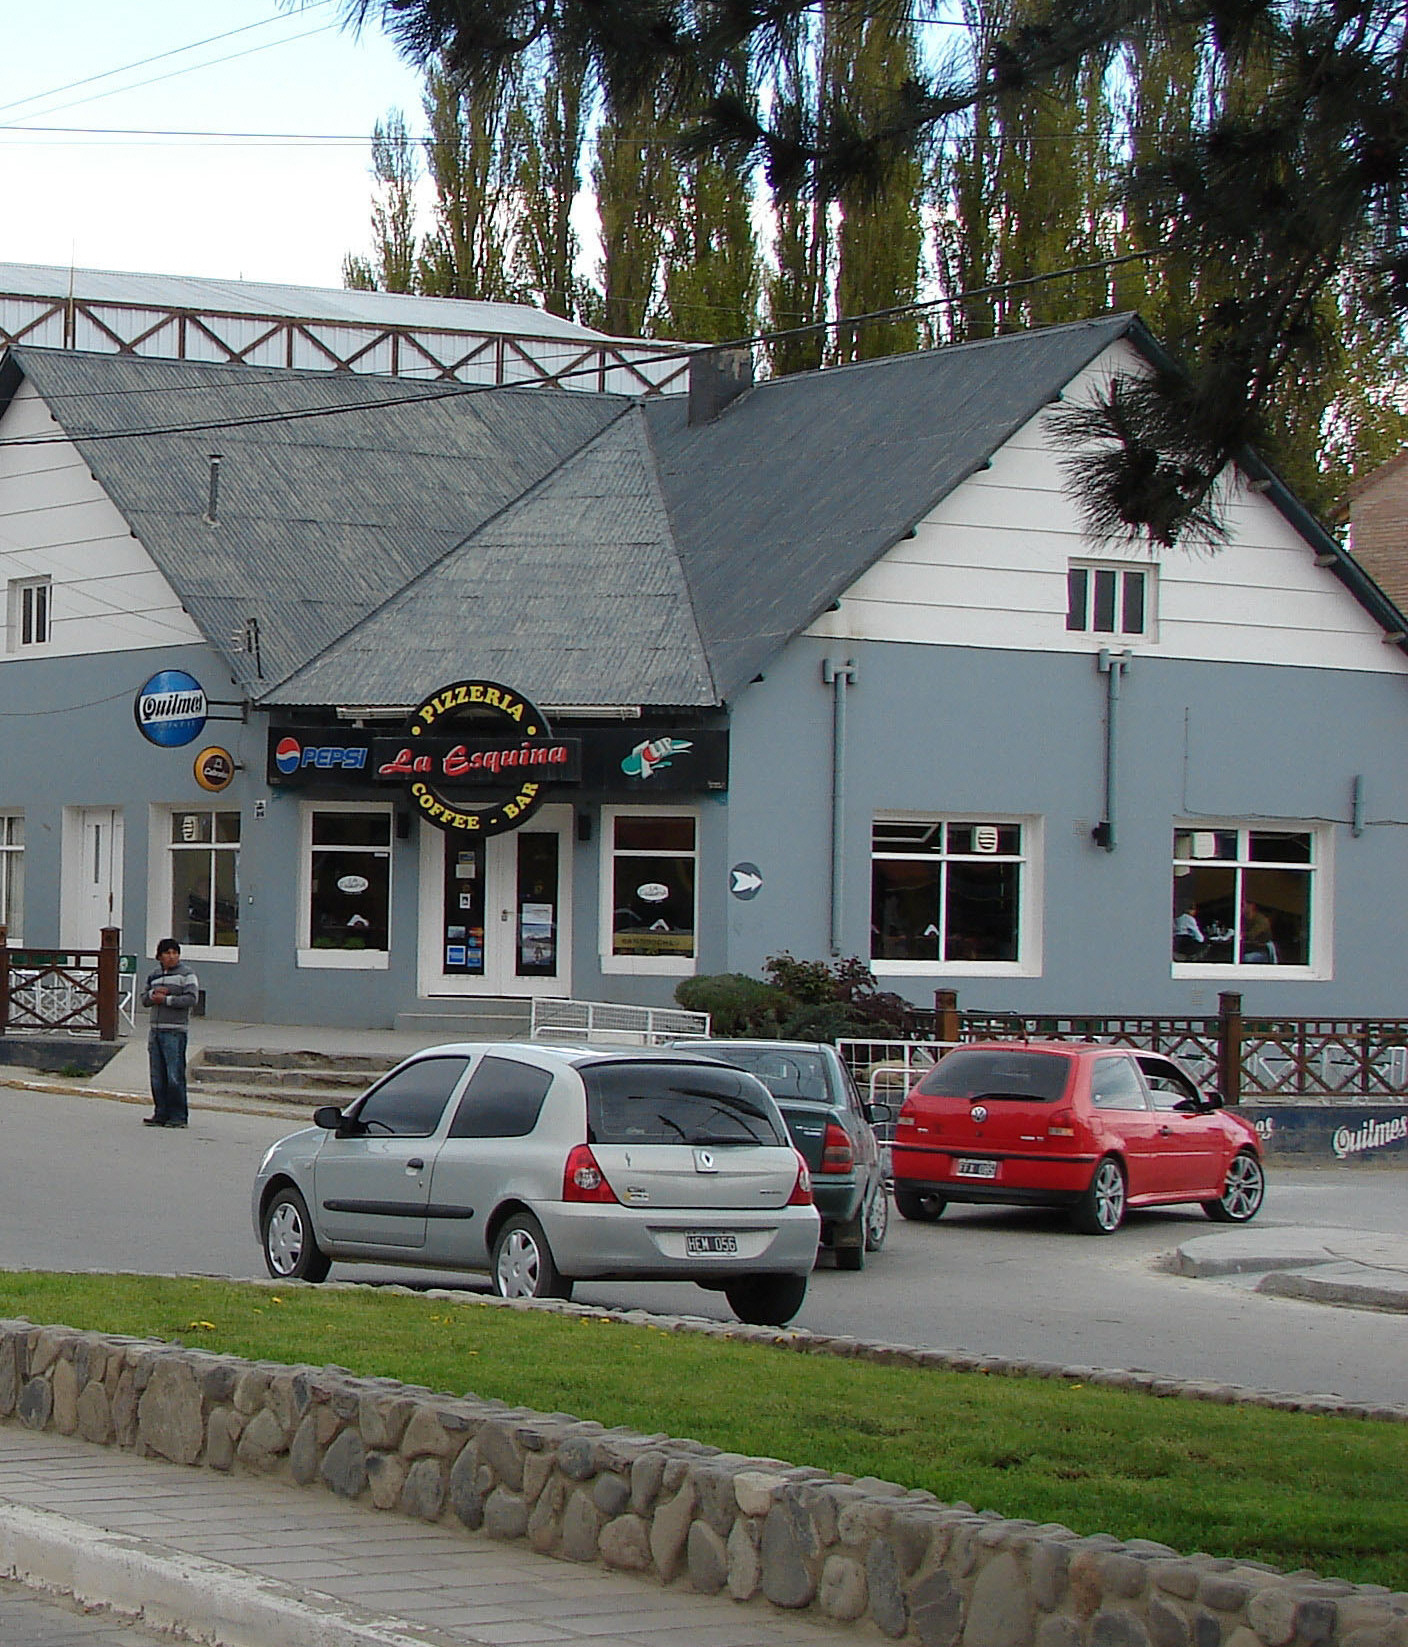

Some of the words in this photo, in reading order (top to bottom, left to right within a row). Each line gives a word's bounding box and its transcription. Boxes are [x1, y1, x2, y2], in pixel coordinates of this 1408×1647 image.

[419, 685, 524, 724] PIZZERIA
[301, 747, 368, 769] PEPSI
[378, 748, 433, 775] La
[442, 741, 568, 776] Esquina
[412, 782, 480, 830] COFFEE
[503, 781, 539, 820] BAR
[1333, 1115, 1408, 1159] Quilmes
[687, 1237, 709, 1251] HEM
[715, 1237, 737, 1251] 056
